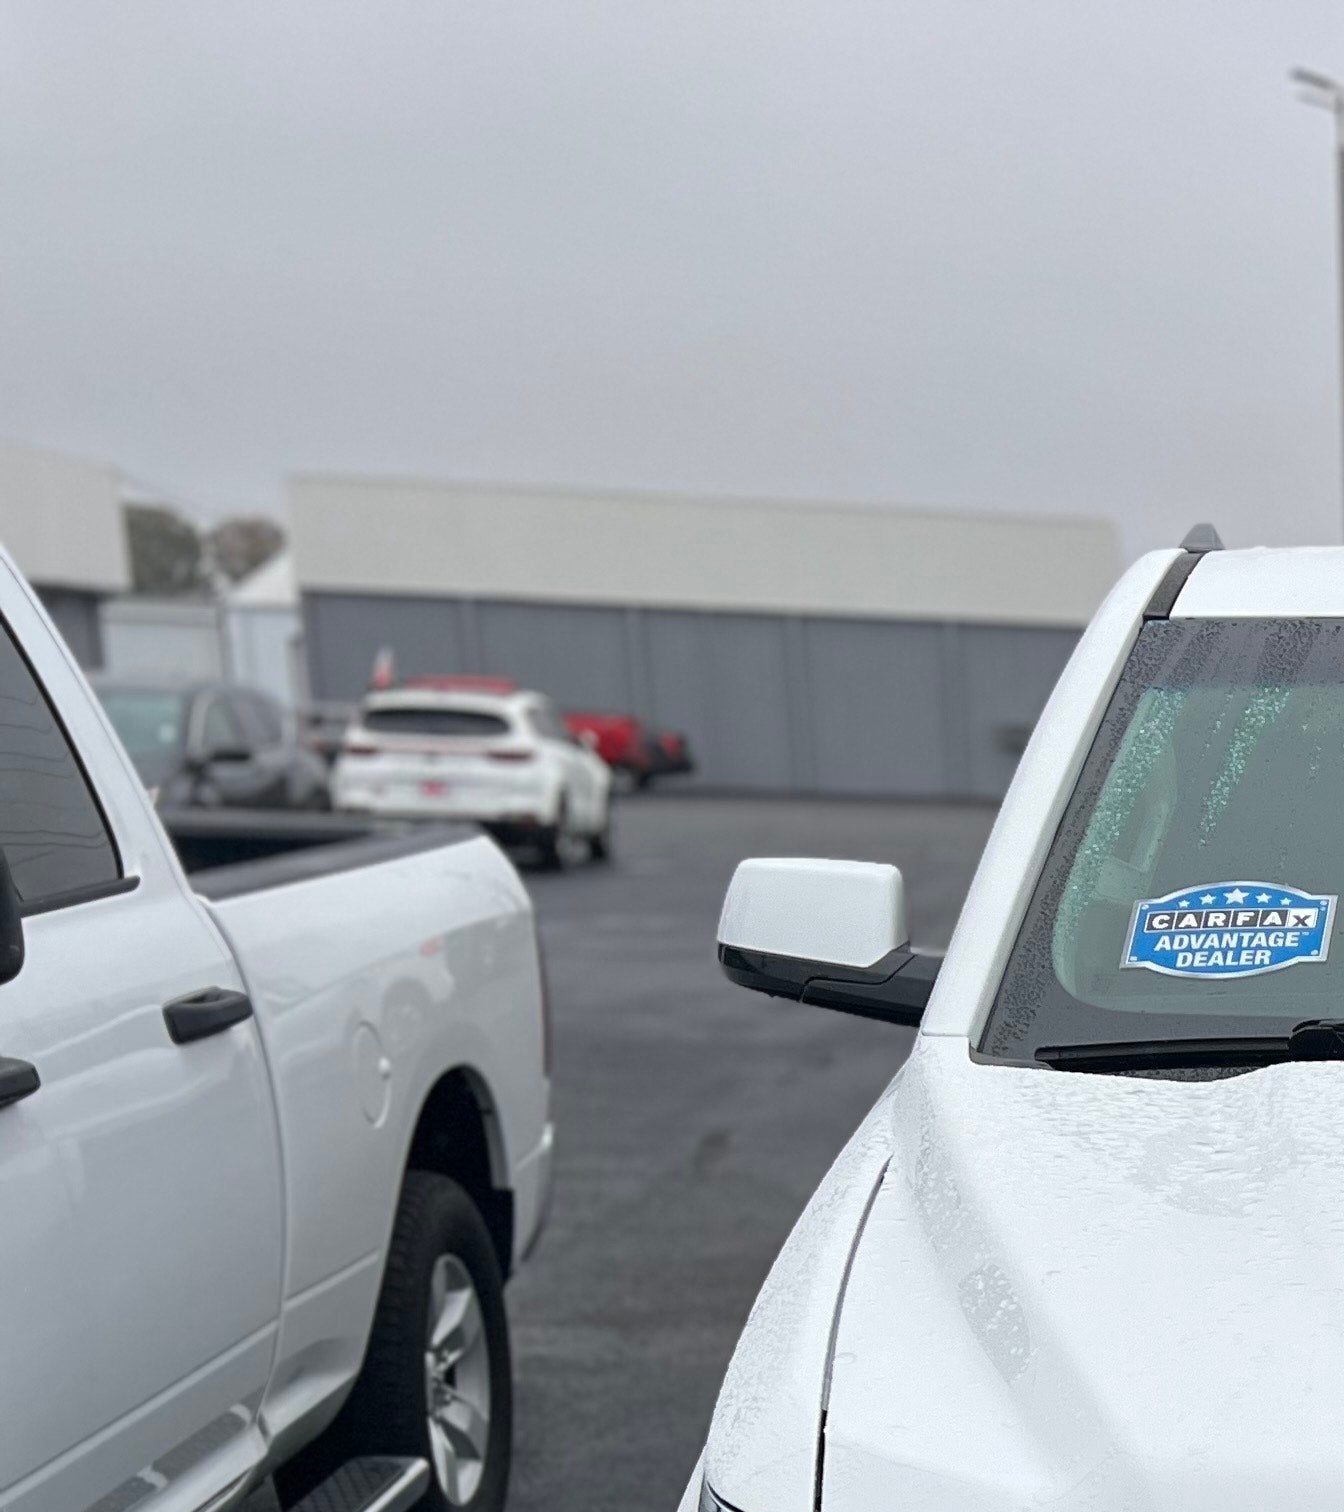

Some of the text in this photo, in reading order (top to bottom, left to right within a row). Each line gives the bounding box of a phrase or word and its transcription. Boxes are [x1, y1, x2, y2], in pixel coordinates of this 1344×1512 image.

[1150, 911, 1311, 929] CARFAX
[1154, 931, 1300, 951] ADVANTAGE
[1175, 950, 1272, 968] DEALER
